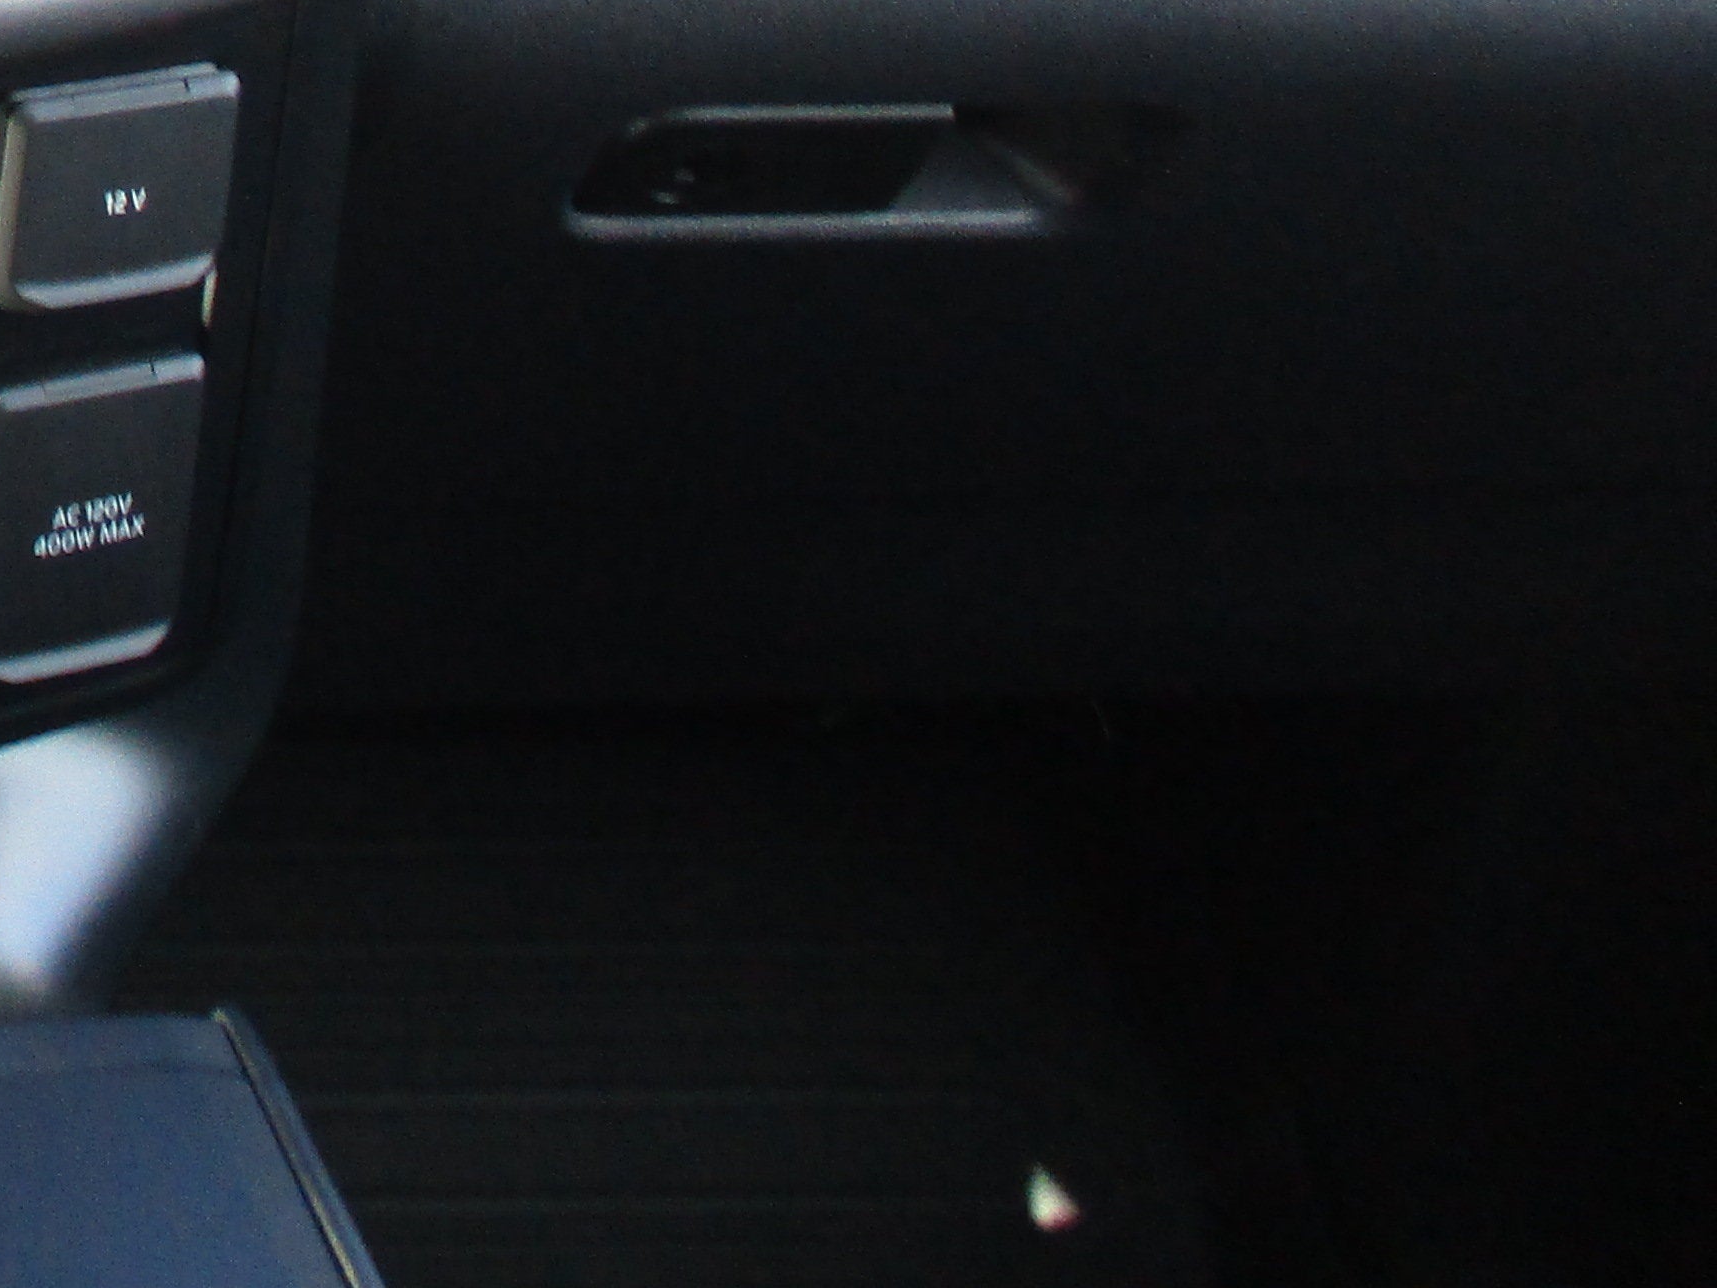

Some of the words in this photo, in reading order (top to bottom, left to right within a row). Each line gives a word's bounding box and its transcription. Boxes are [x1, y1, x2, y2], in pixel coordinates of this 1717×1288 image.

[52, 504, 80, 530] AC
[84, 491, 133, 525] 120V
[33, 525, 94, 558] 400W
[100, 512, 144, 545] MAX
